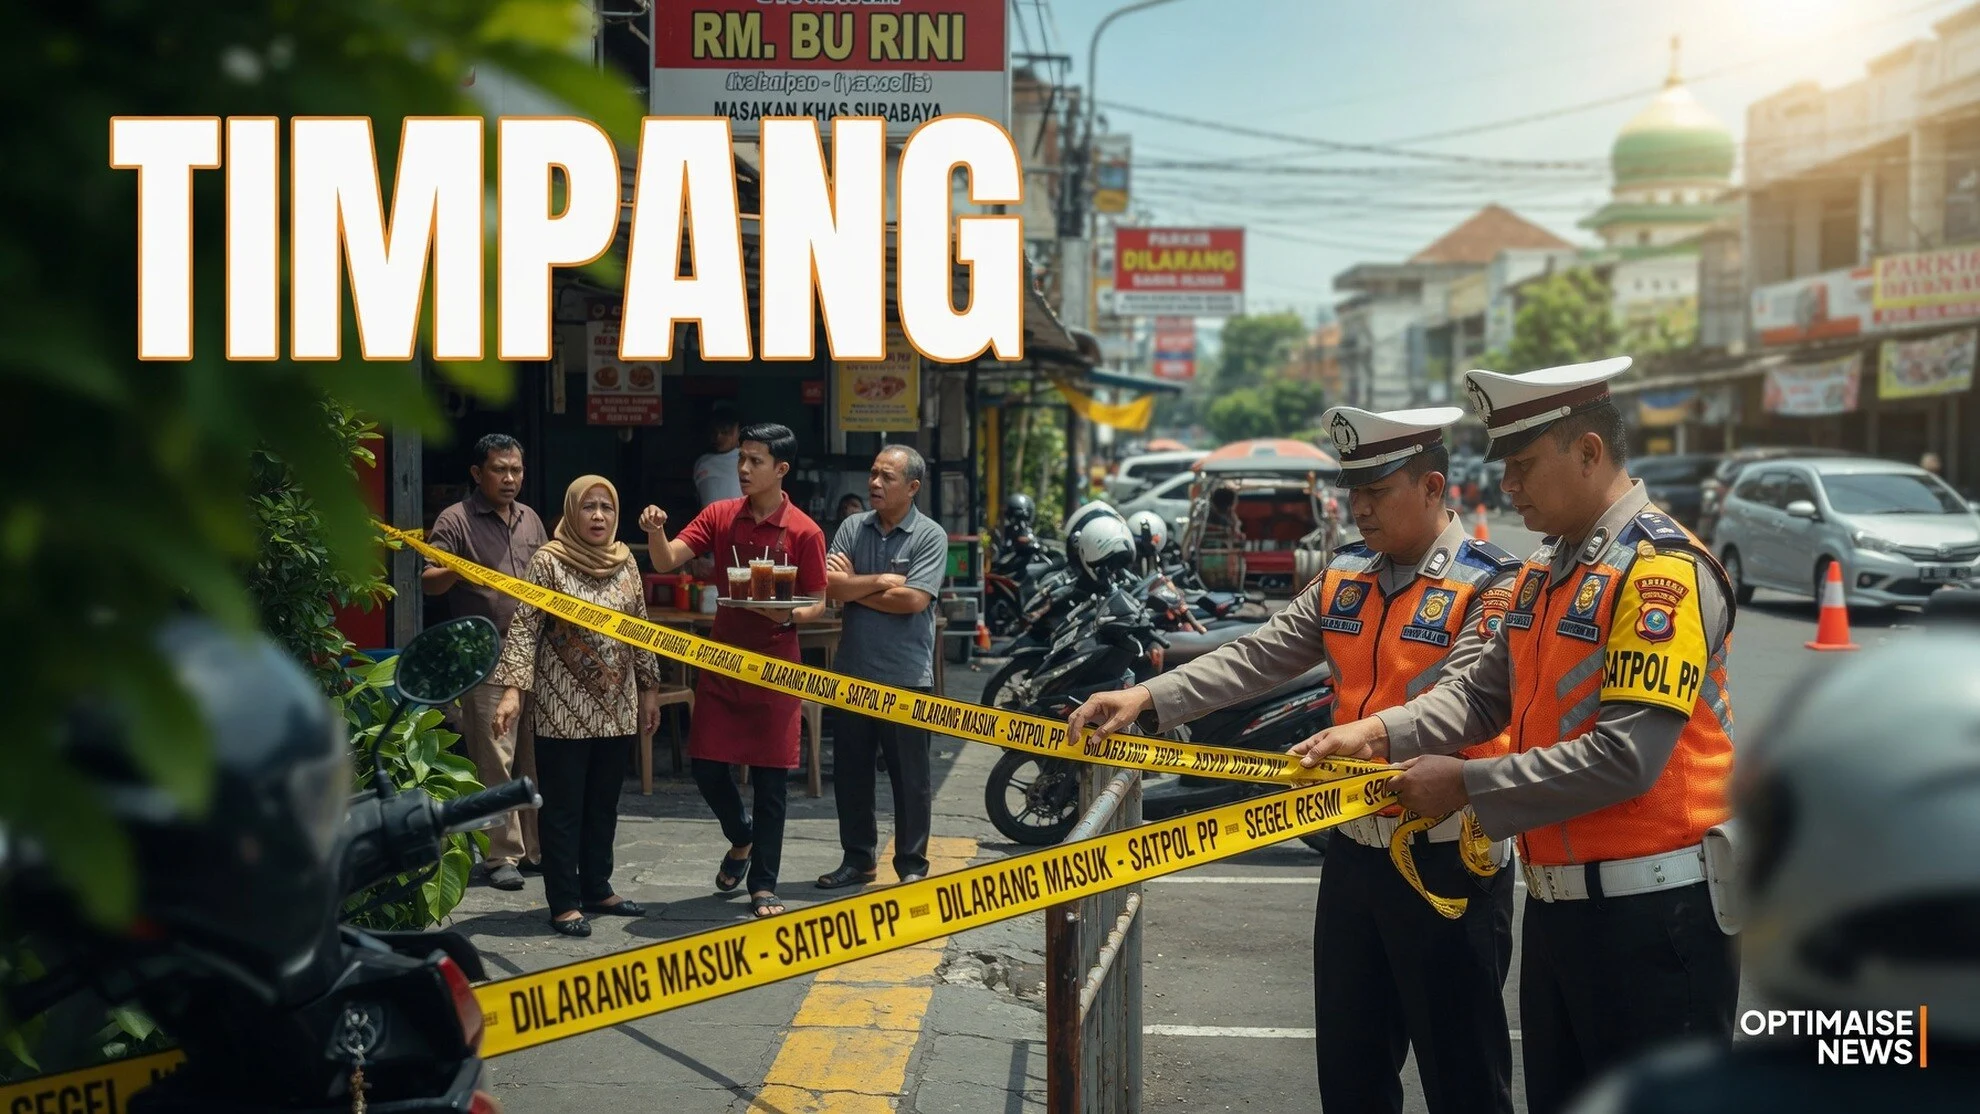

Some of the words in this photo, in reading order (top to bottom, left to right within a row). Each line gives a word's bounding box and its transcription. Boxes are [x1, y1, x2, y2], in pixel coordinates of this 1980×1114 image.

[691, 11, 776, 60] RM.
[791, 12, 855, 61] BU
[868, 12, 967, 61] RINI
[714, 101, 797, 121] MASAKAN
[801, 101, 849, 121] KHAS
[854, 102, 942, 122] SURABAYA
[1122, 249, 1237, 272] DILARANG
[1677, 660, 1699, 702] PP
[760, 661, 805, 693] DILARANG
[805, 672, 841, 701] MASUK
[845, 682, 880, 711] SATPOL
[881, 692, 897, 714] PP
[911, 698, 960, 730] DILARANG
[960, 708, 999, 738] MASUK
[1006, 718, 1045, 748] SATPOL
[1048, 727, 1066, 751] PP
[509, 961, 651, 1034] DILARANG
[656, 935, 752, 996] MASUK
[775, 909, 867, 966] SATPOL
[870, 899, 901, 941] PP
[936, 864, 1040, 923] DILARANG
[1042, 845, 1113, 895] MASUK
[1128, 825, 1196, 871] SATPOL
[1196, 818, 1218, 853] PP
[1244, 799, 1294, 840] SEGEL
[1295, 788, 1343, 826] RESMI
